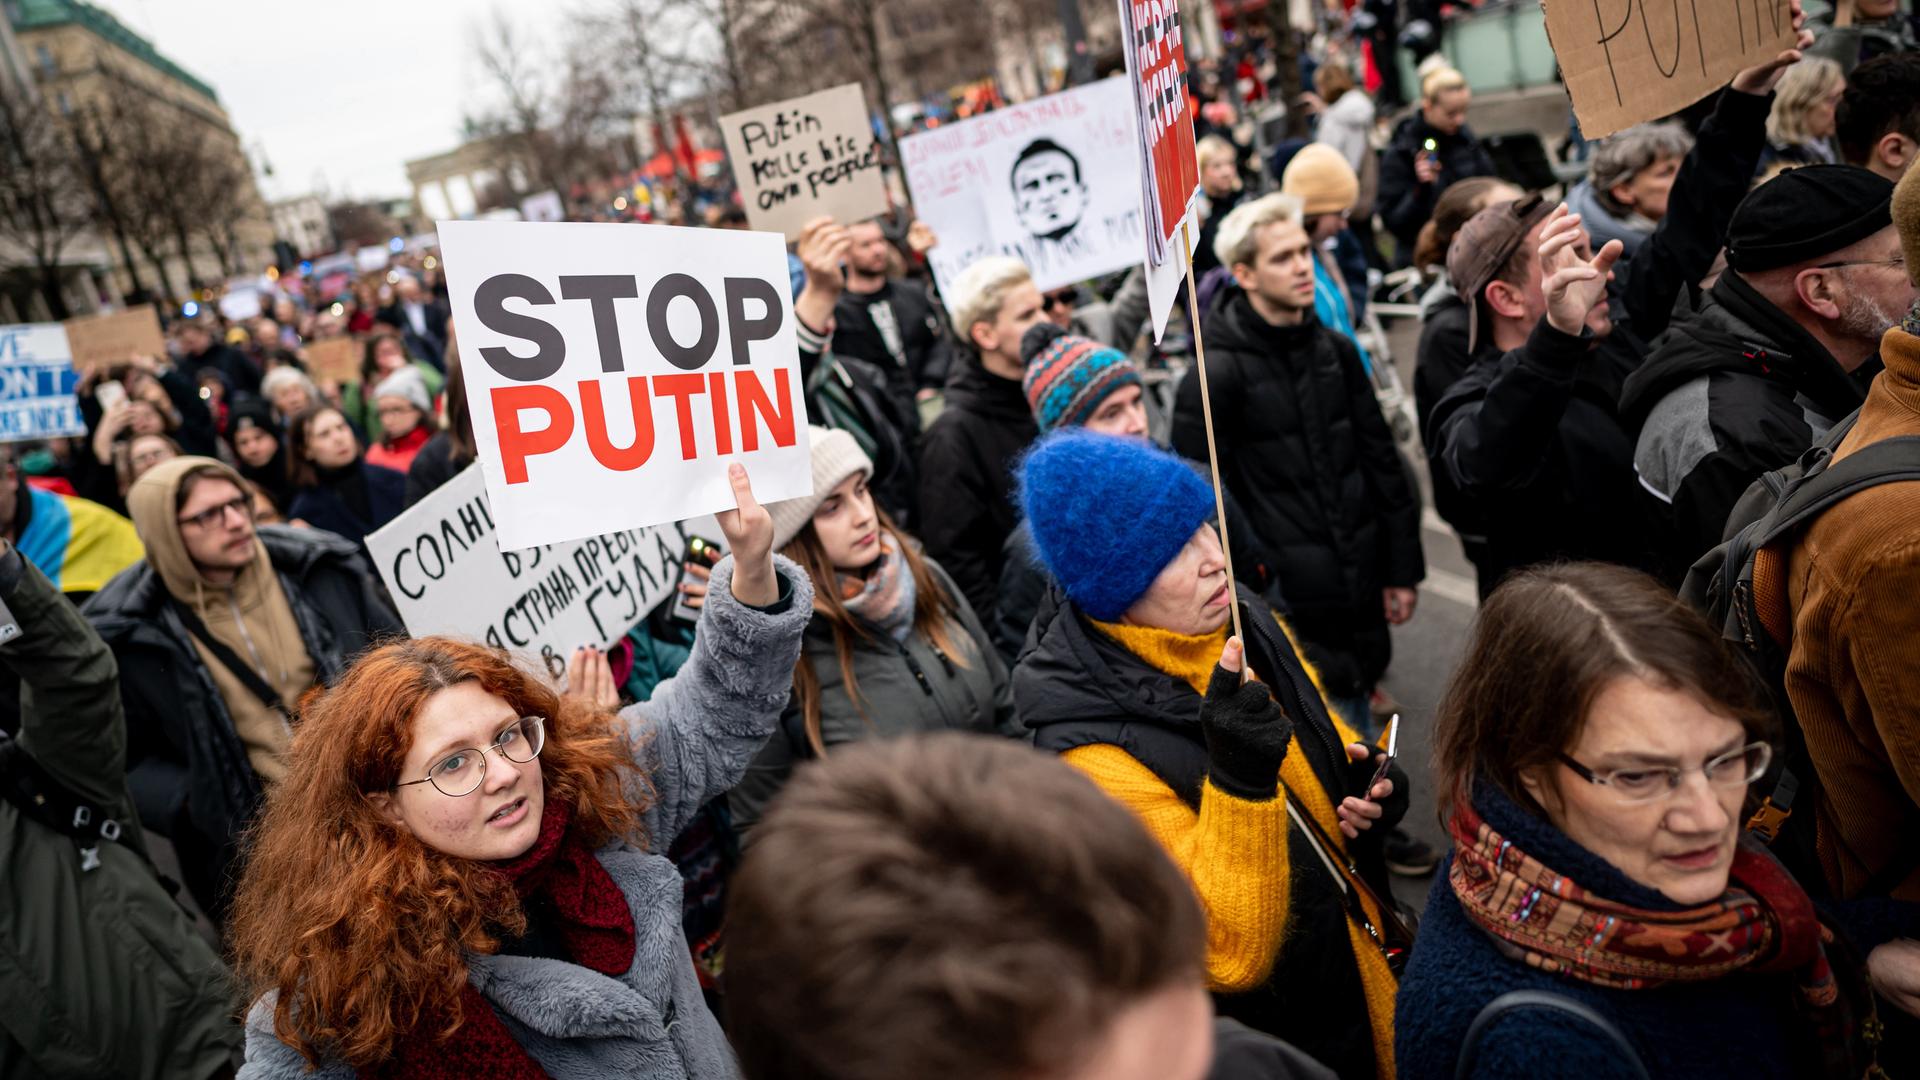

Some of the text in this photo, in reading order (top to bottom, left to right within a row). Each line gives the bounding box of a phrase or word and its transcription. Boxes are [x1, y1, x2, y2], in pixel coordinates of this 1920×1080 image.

[739, 110, 821, 154] Putin
[473, 273, 783, 382] STOP
[490, 368, 796, 485] PUTIN
[503, 564, 581, 648] СТРАНА
